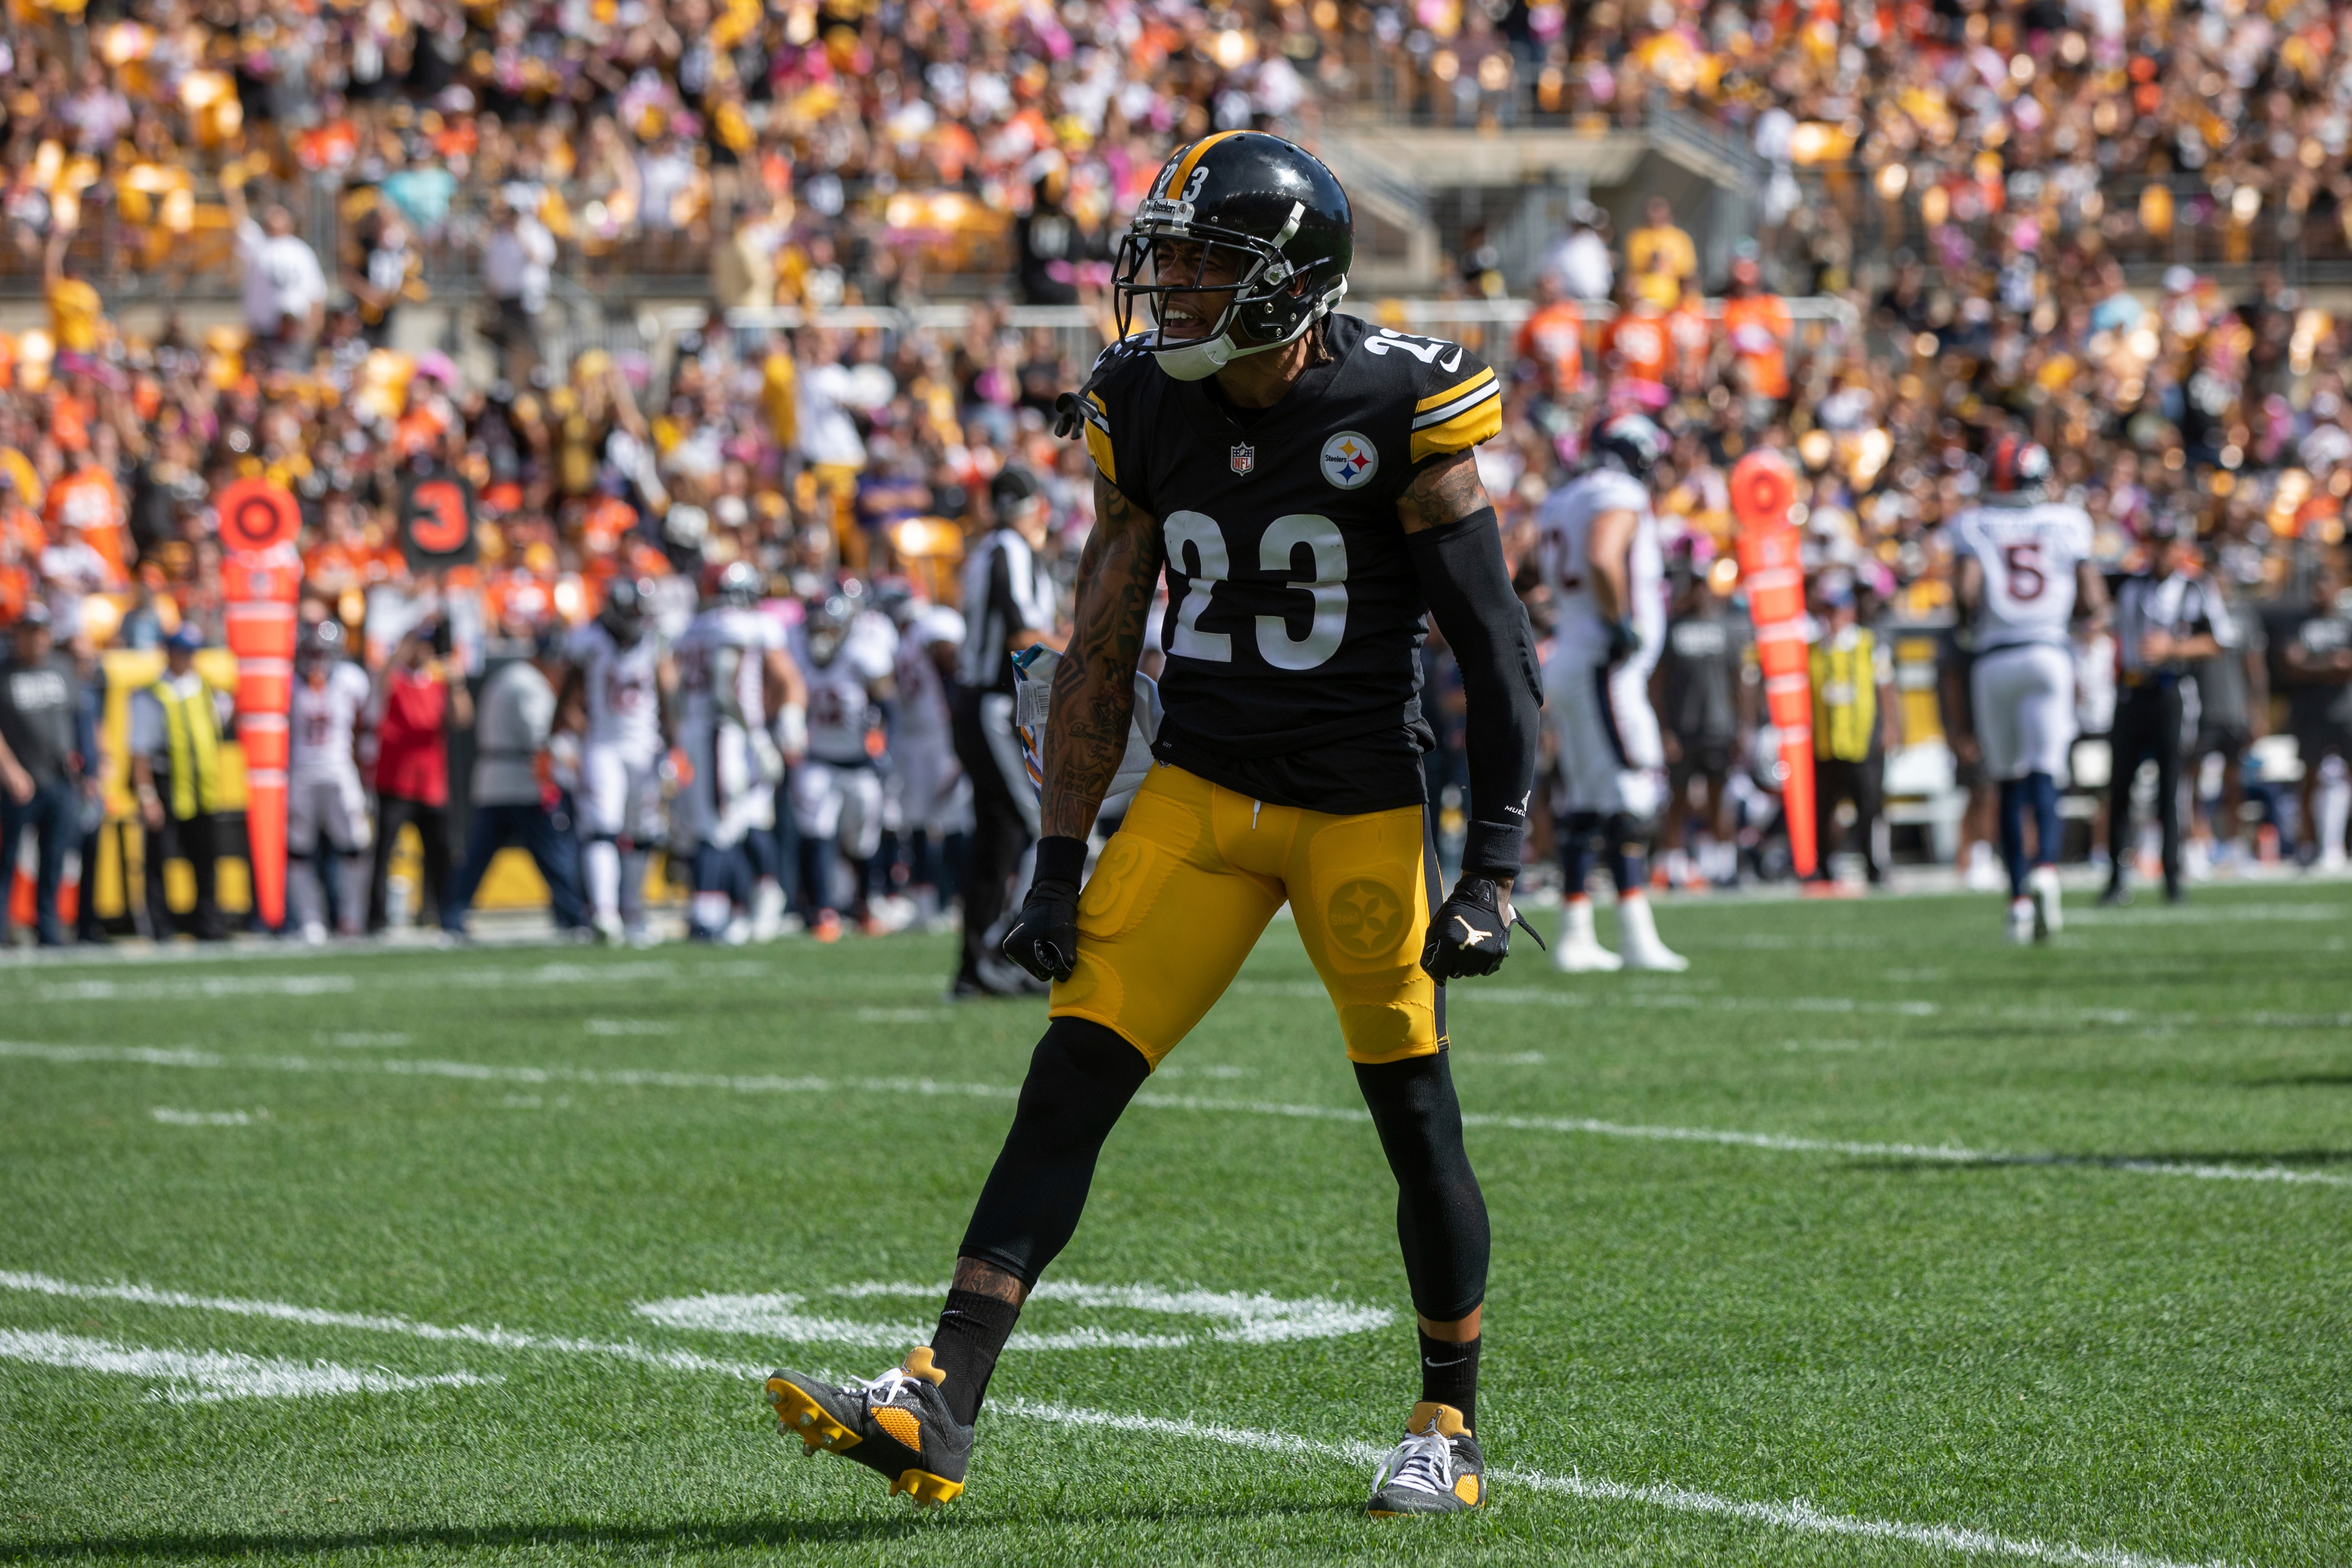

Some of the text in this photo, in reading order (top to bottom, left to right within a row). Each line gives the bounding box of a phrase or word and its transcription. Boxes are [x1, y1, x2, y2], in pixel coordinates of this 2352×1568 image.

[1153, 163, 1209, 202] 23
[1234, 457, 1250, 470] NFL
[1325, 454, 1347, 463] Steelers
[410, 479, 469, 554] 3
[2005, 540, 2046, 604] 5
[1163, 510, 1349, 670] 23
[1068, 722, 1112, 746] Dreams
[1088, 744, 1112, 762] True
